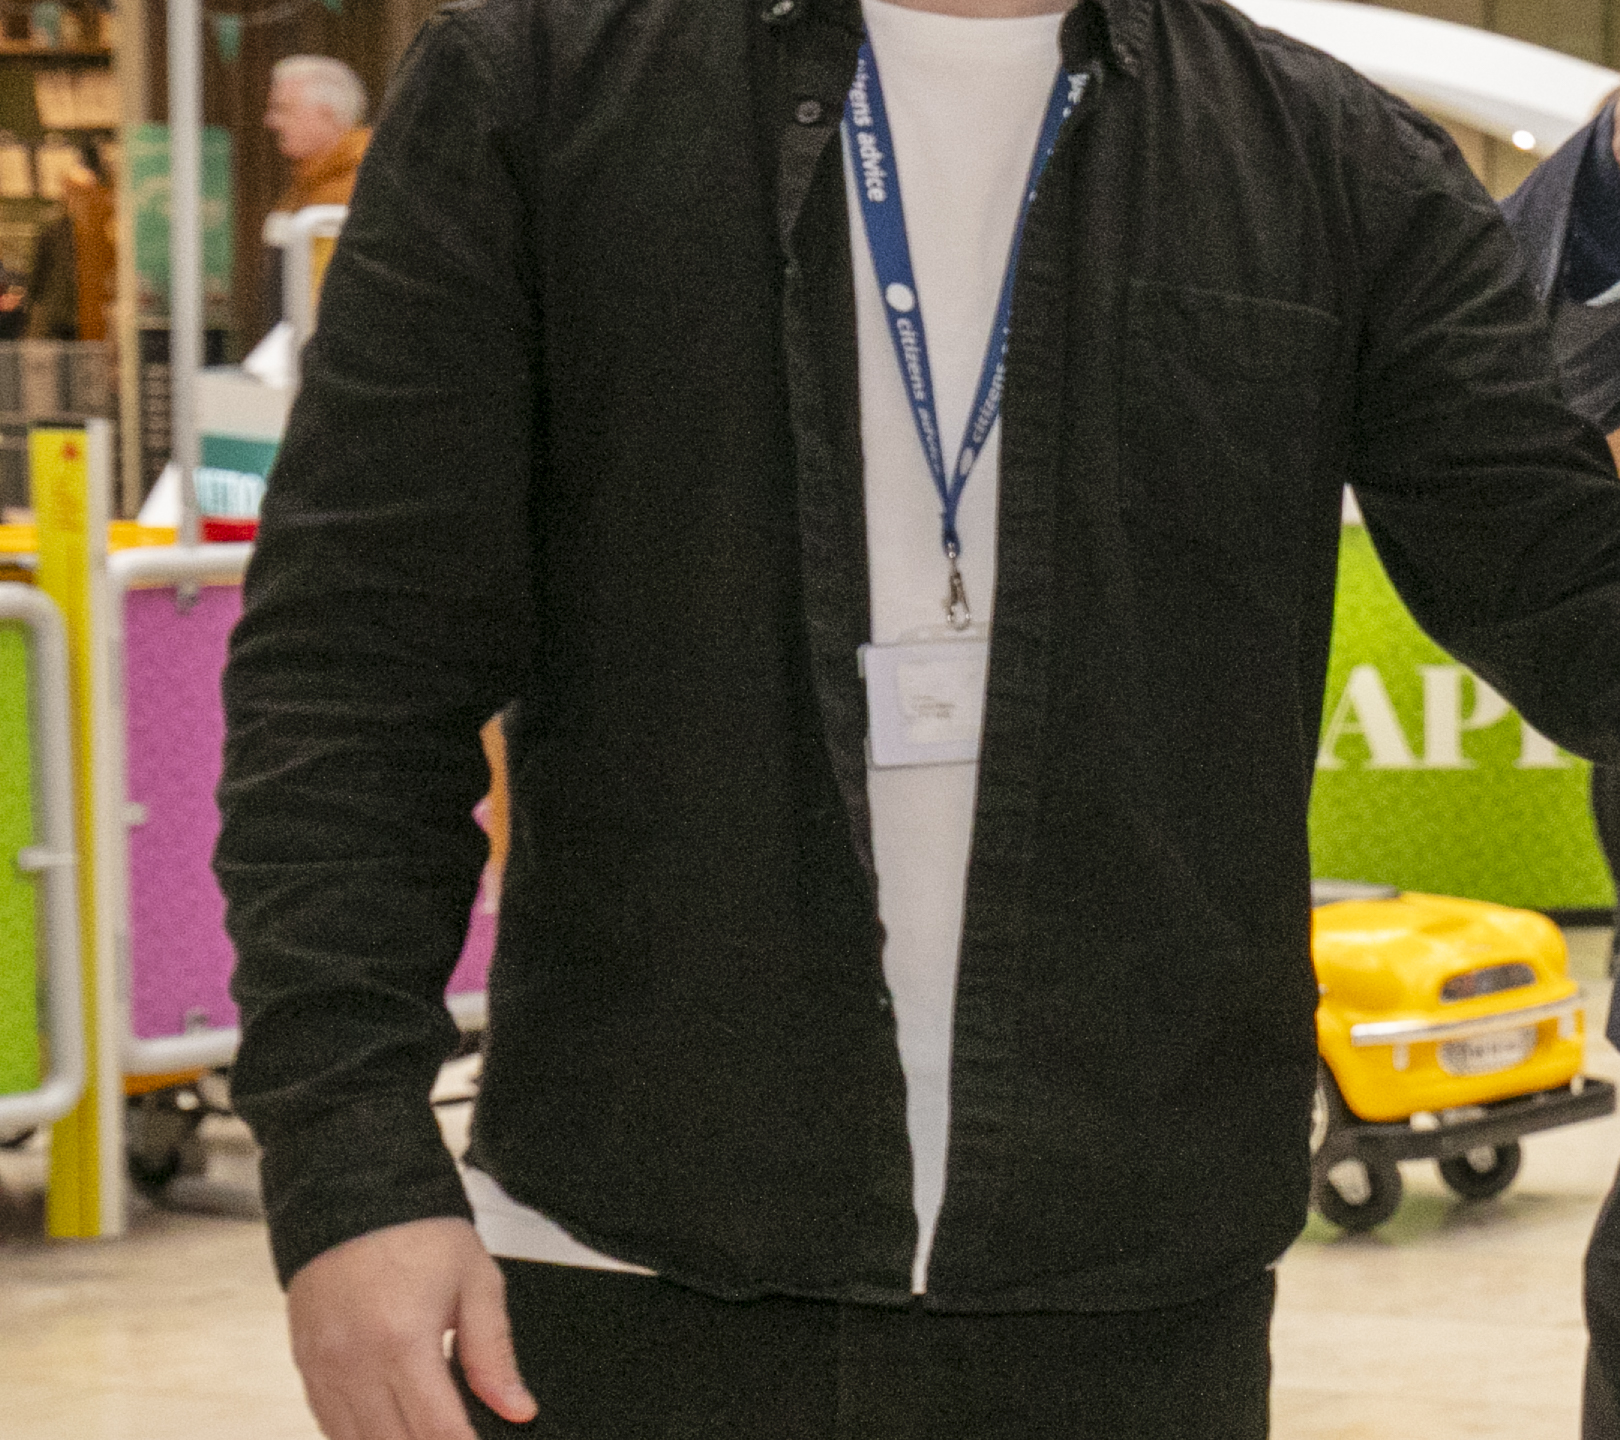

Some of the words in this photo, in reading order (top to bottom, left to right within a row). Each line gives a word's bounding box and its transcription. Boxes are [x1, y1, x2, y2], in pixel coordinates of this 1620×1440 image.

[856, 130, 888, 203] advice
[896, 317, 926, 401] citizens
[1315, 662, 1576, 770] AP
